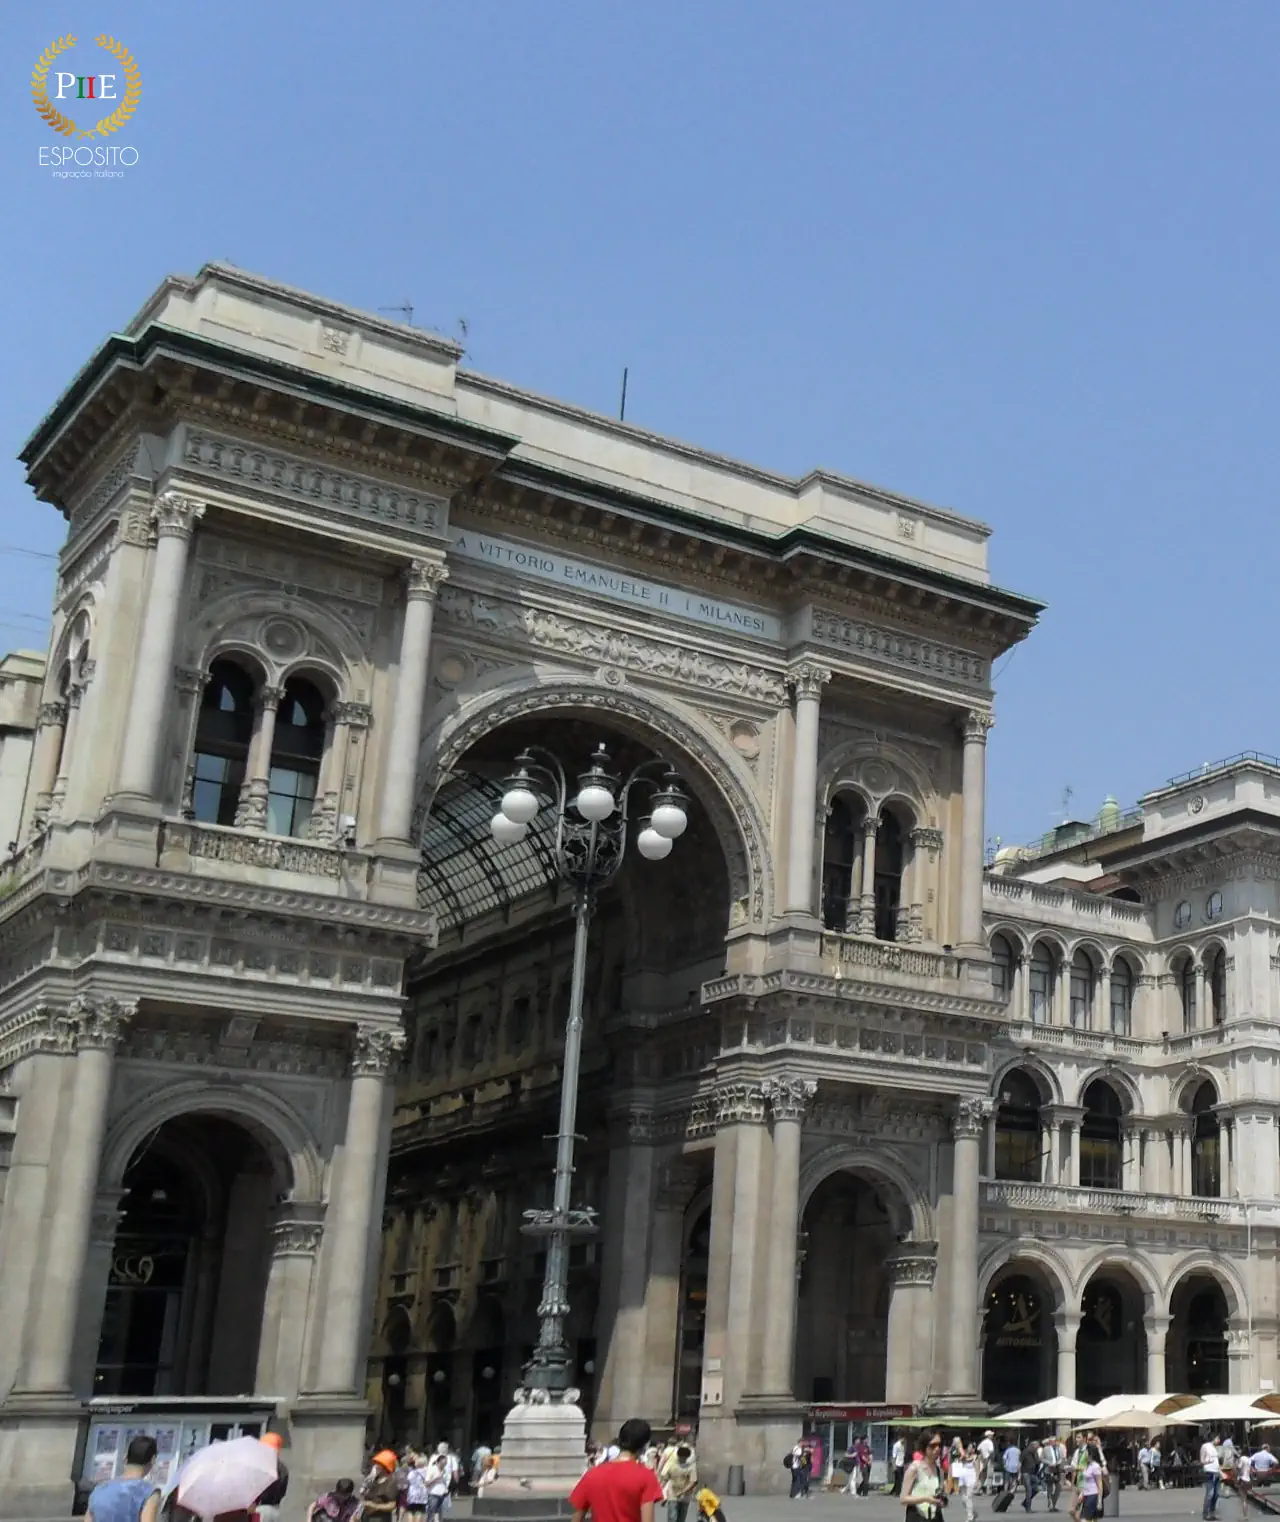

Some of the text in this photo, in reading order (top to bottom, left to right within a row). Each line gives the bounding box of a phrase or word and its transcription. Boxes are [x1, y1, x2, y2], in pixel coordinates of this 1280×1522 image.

[479, 540, 554, 573] VITTORIO
[563, 565, 651, 600] EMANUELE
[699, 603, 766, 633] MILANESI
